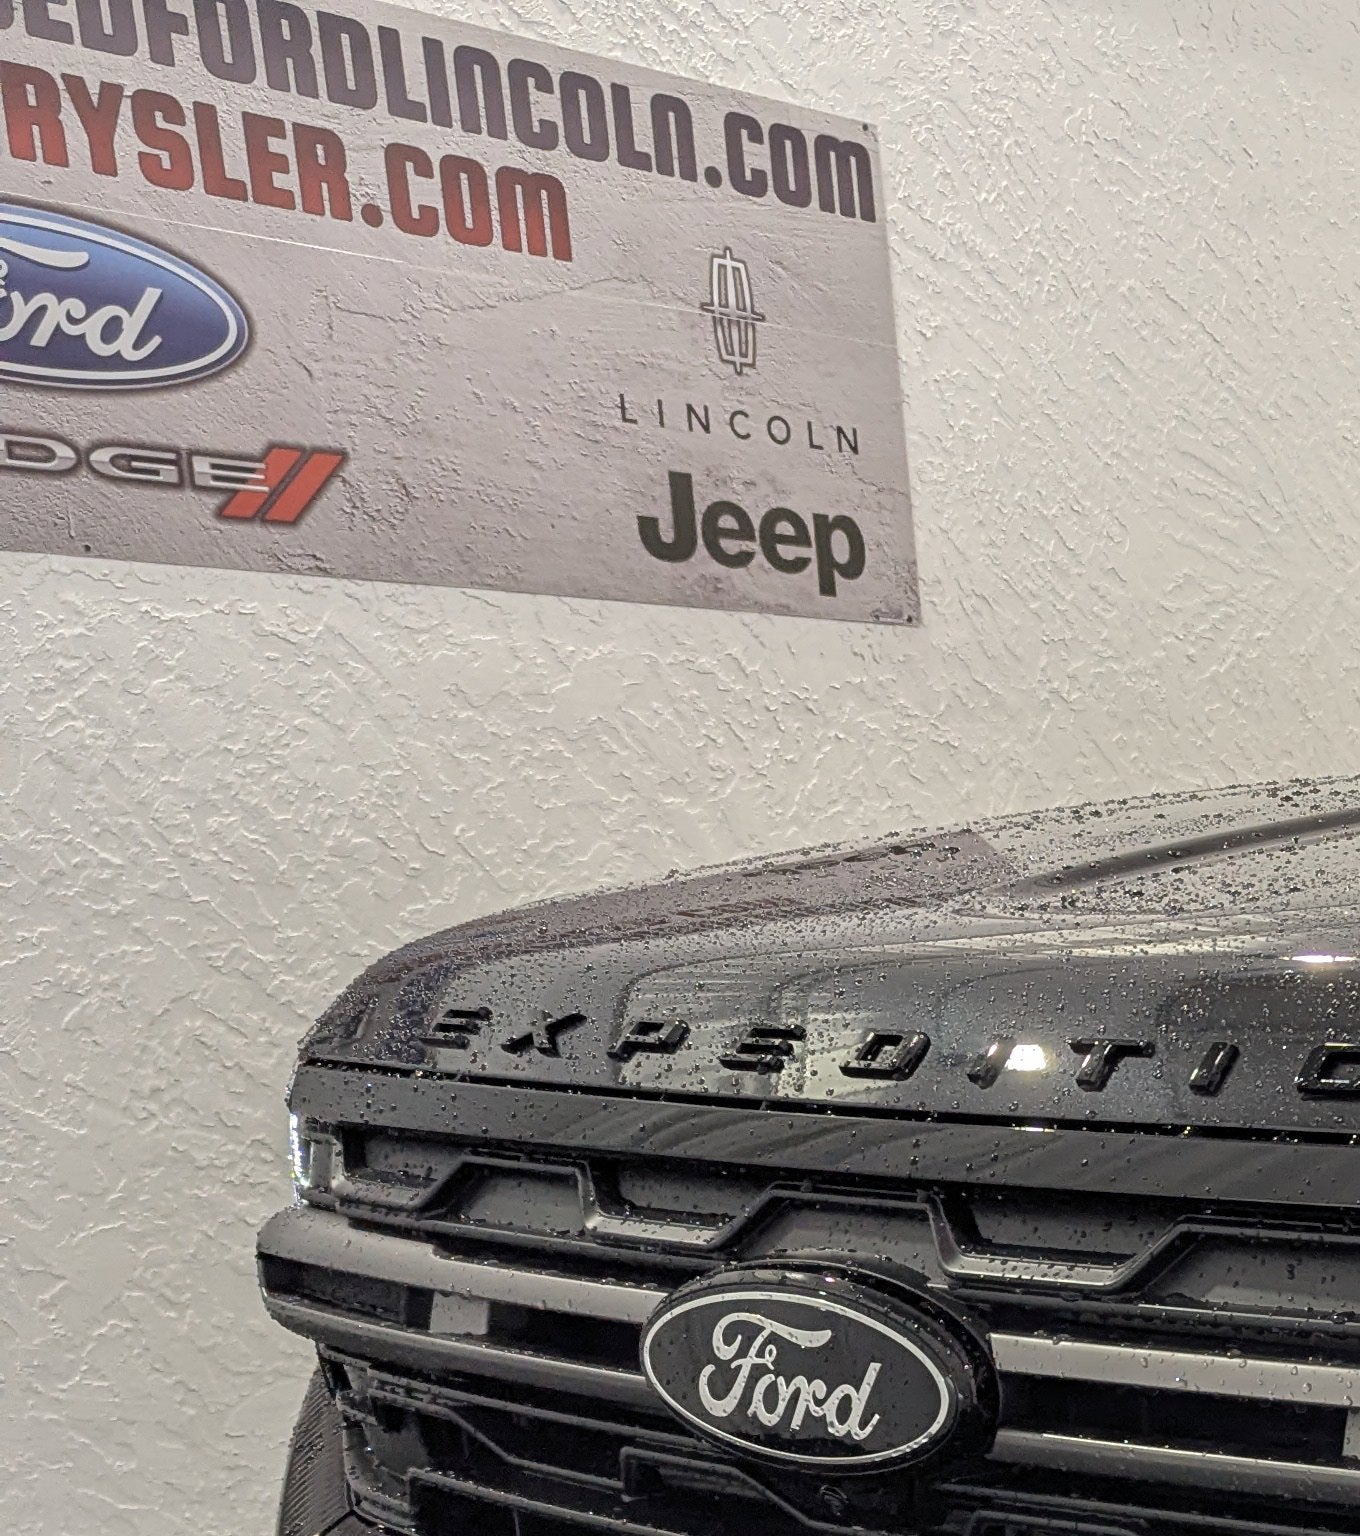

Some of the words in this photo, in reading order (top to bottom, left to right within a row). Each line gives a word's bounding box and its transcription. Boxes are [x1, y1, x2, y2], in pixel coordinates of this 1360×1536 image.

[0, 0, 877, 222] DFORDLINCOLN.COM
[619, 393, 860, 455] LINCOLN
[637, 471, 866, 597] Jeep
[700, 1312, 882, 1441] Ford
